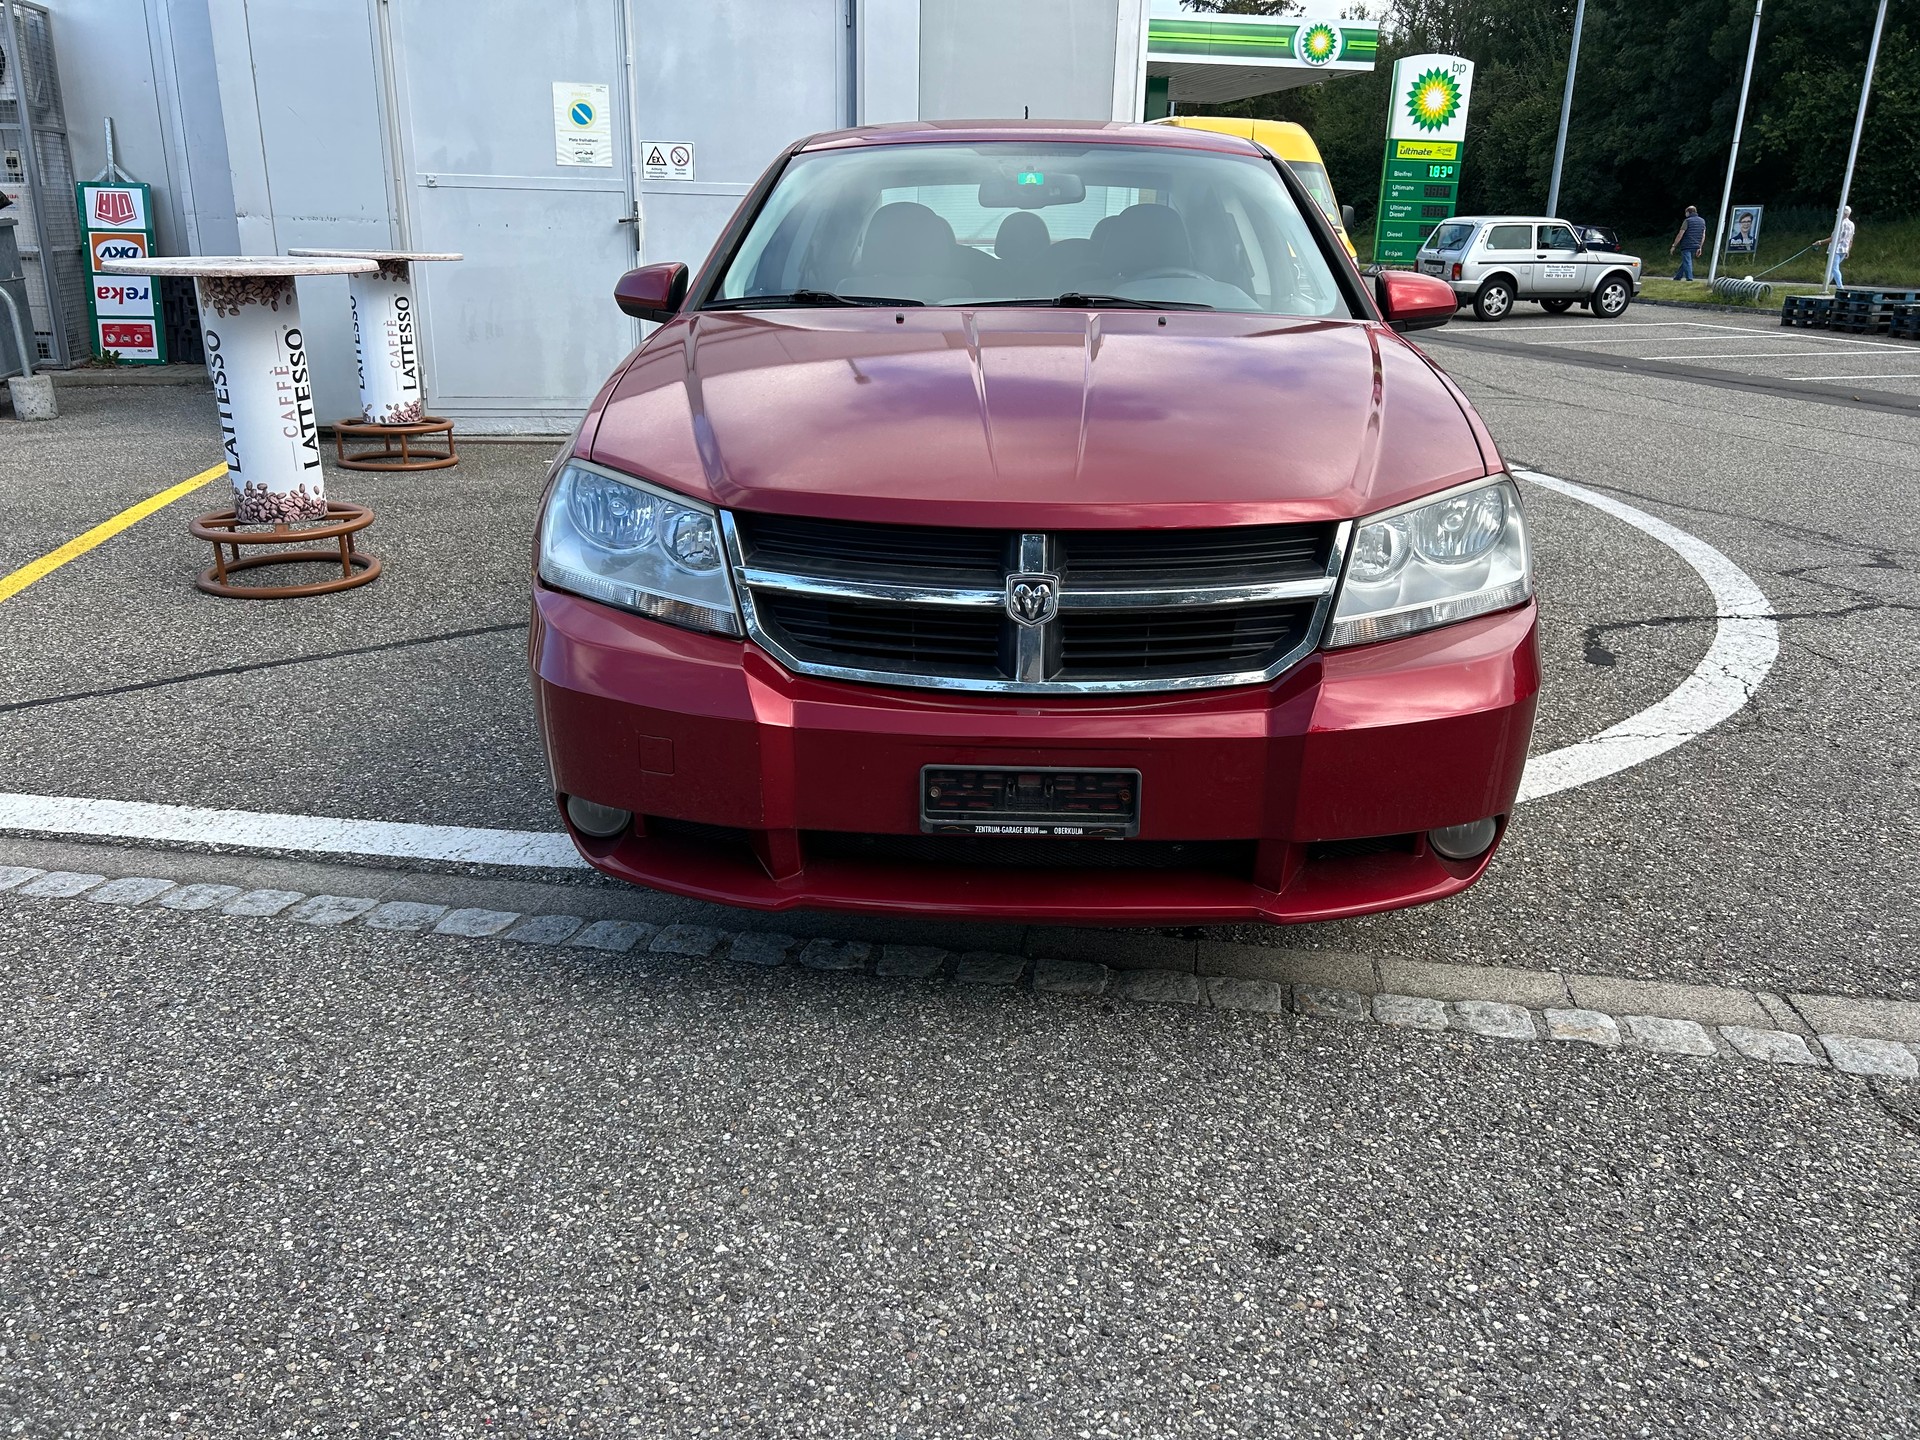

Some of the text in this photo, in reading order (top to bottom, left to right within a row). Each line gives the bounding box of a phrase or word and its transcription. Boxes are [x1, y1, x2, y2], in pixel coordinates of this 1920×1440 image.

[1452, 61, 1467, 76] bp
[1400, 147, 1432, 156] ultimate
[97, 193, 135, 225] UTA
[100, 246, 139, 259] DKV
[97, 286, 149, 304] reka
[383, 320, 401, 369] CAFFÈ
[394, 296, 417, 391] LATTESSO
[269, 365, 299, 439] CAFFÈ
[284, 328, 320, 471] LATTESSO
[974, 825, 1023, 834] ZENTRUM-GARAGE
[1023, 826, 1039, 834] BRUN
[1053, 827, 1083, 835] OBERKULM
